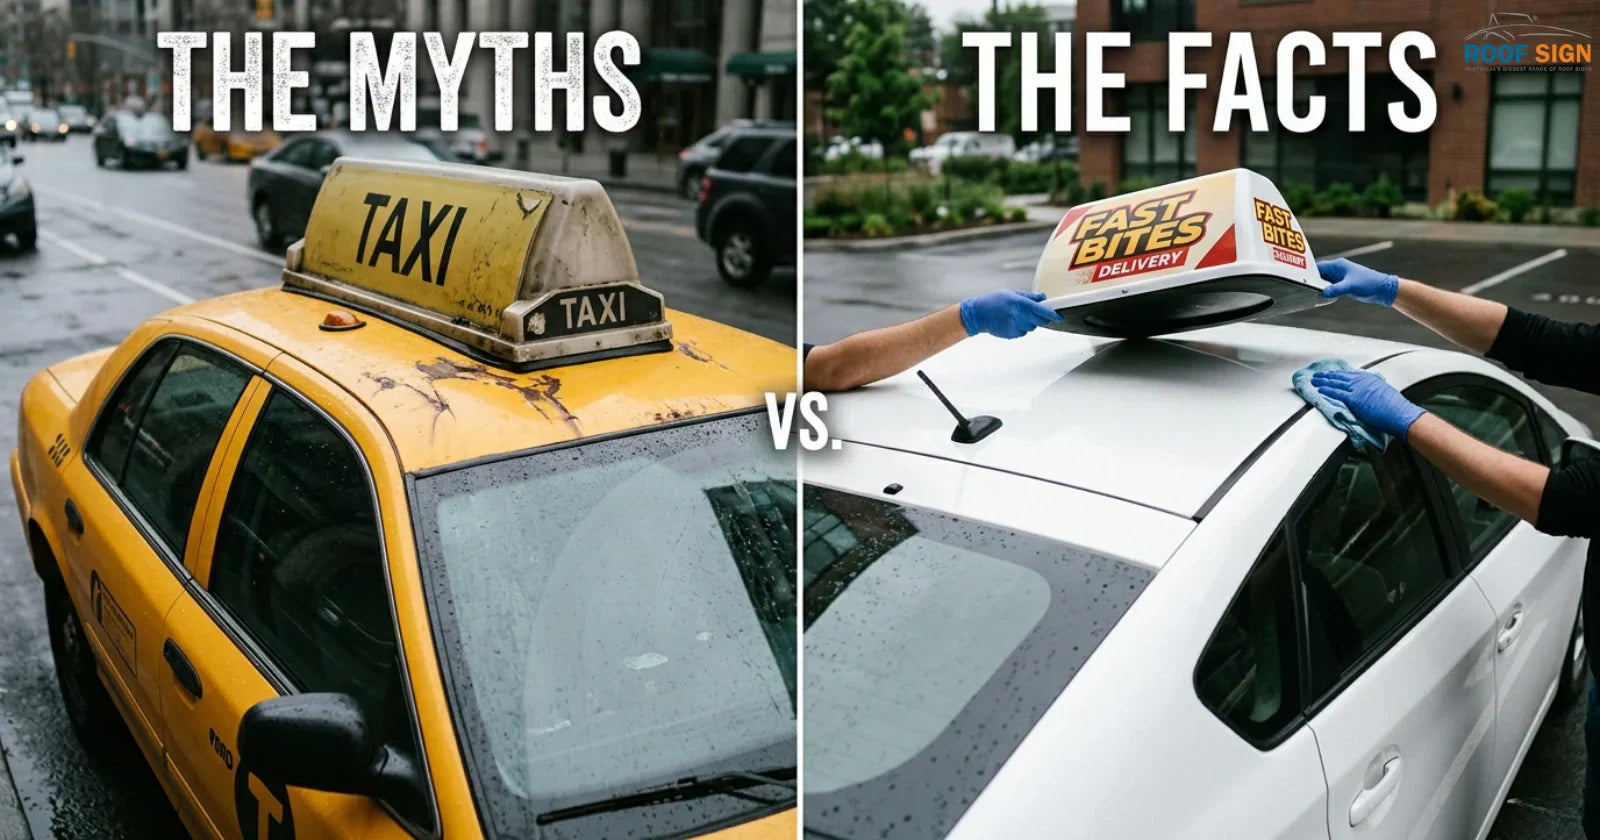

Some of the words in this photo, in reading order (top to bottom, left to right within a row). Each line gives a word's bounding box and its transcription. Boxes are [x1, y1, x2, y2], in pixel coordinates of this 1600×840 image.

[1076, 193, 1192, 239] FAST
[1255, 201, 1291, 229] FAST
[356, 192, 467, 287] TAXI
[1073, 215, 1206, 265] BITES
[1263, 222, 1304, 252] BITES
[1098, 250, 1184, 278] DELIVERY
[560, 291, 627, 330] TAXI
